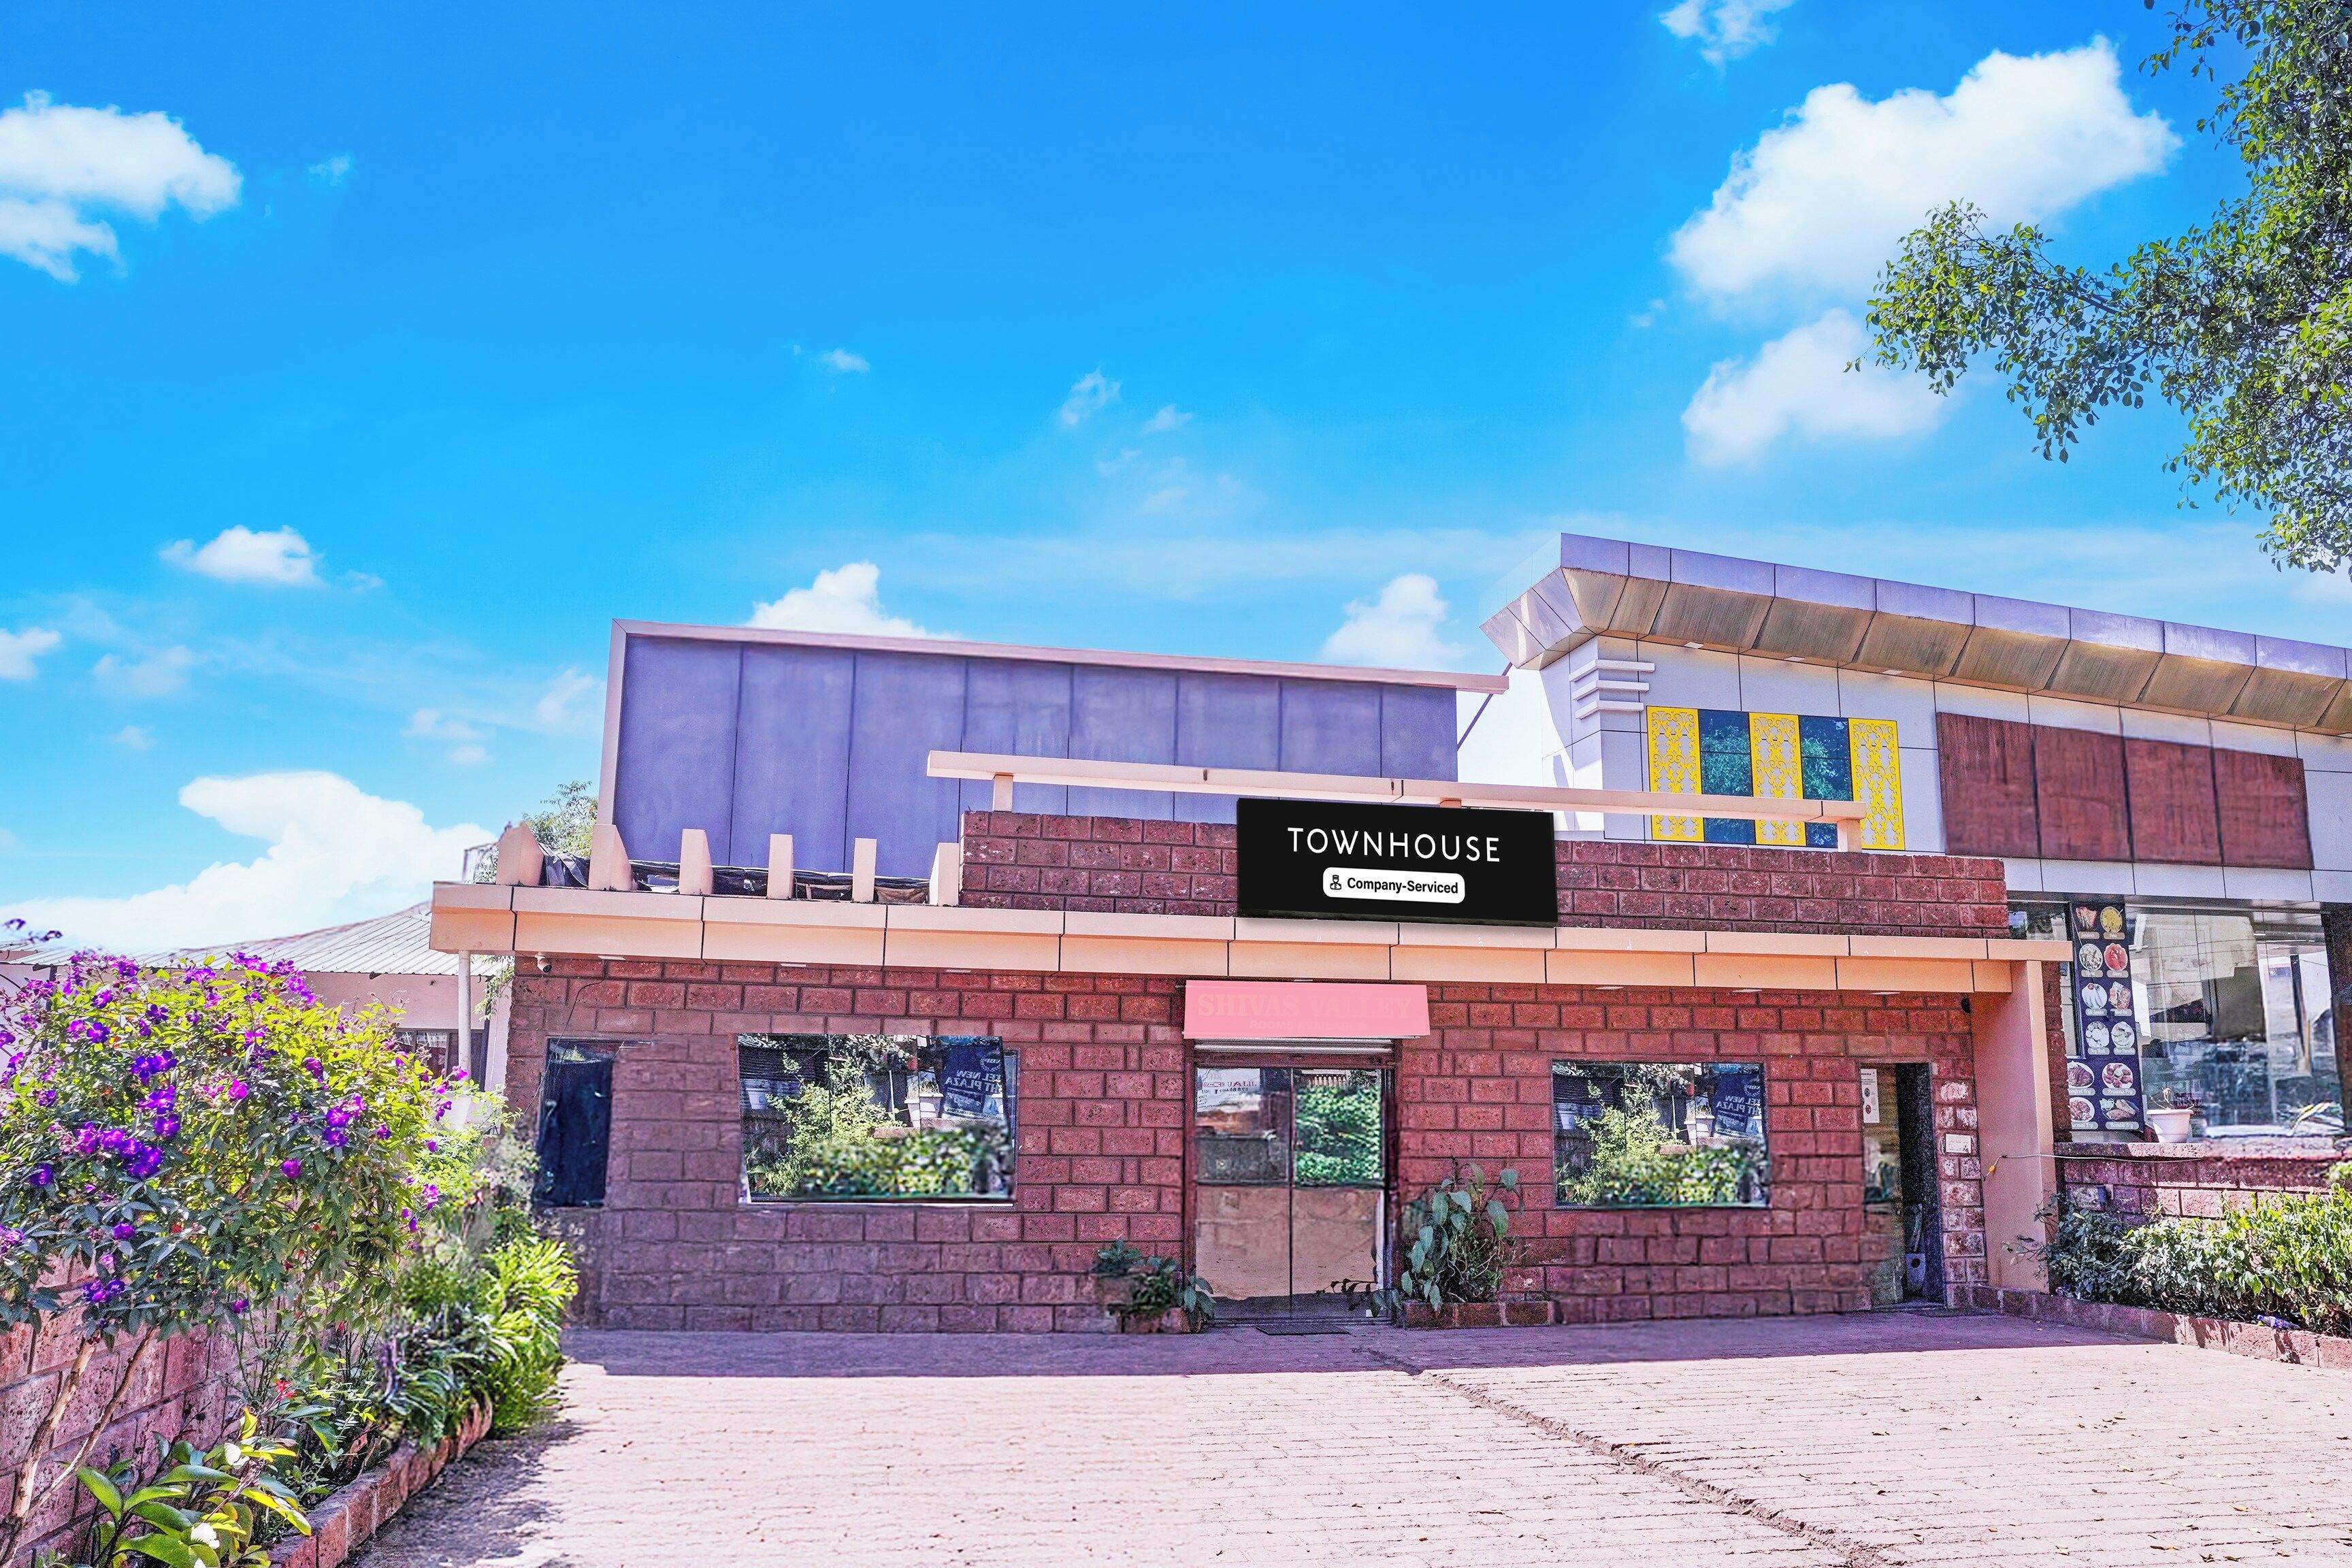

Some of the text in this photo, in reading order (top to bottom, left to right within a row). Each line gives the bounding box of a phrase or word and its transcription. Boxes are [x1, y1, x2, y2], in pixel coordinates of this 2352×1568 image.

[1288, 827, 1500, 862] TOWNHOUSE
[1347, 877, 1458, 895] Company-Serviced
[1198, 993, 1412, 1020] SHIVAS VALLEY
[1250, 1020, 1294, 1030] ROOMS
